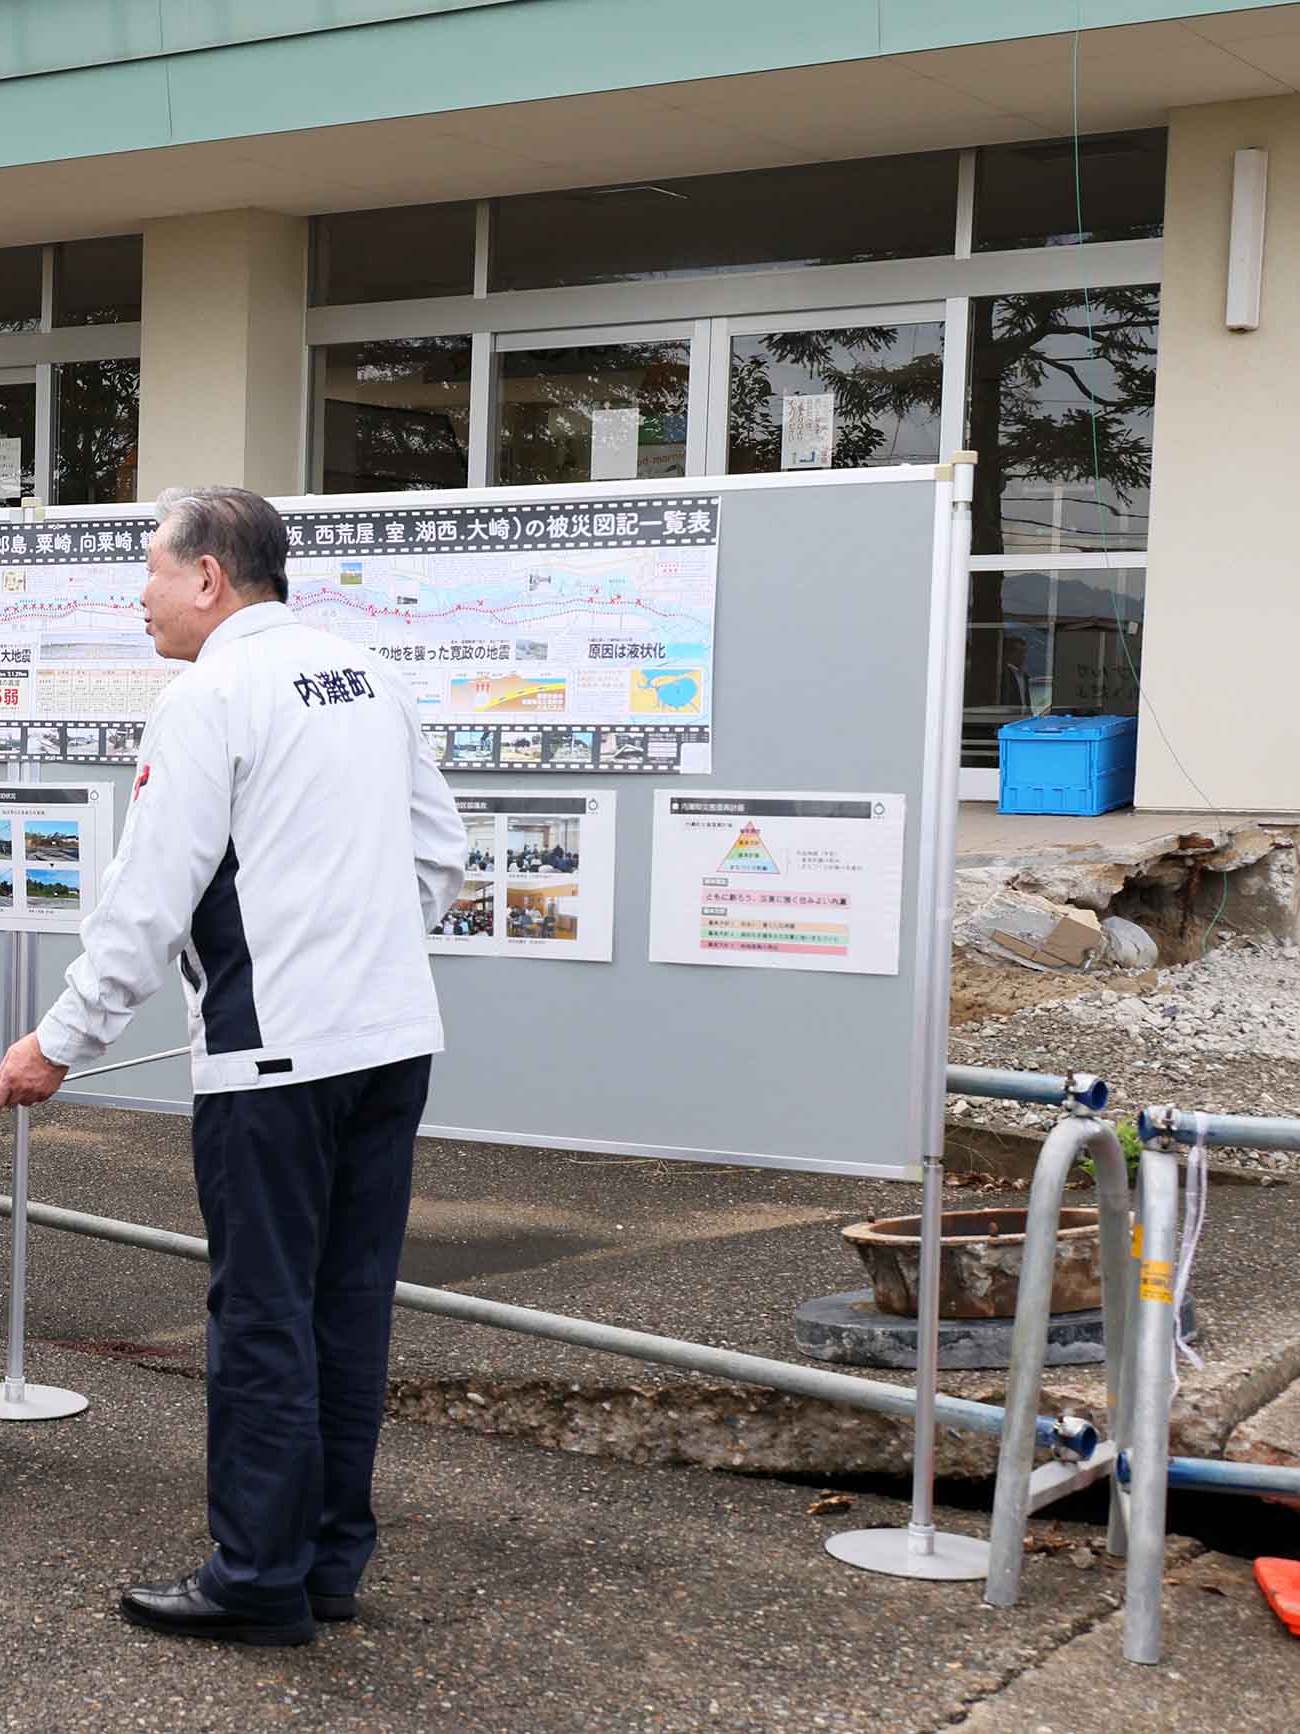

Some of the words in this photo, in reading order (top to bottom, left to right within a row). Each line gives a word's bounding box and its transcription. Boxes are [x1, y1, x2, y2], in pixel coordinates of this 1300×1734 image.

[369, 645, 509, 661] の地を襲った寛政の地震
[588, 643, 666, 659] 原因は液状化
[293, 668, 375, 707] 内灘町
